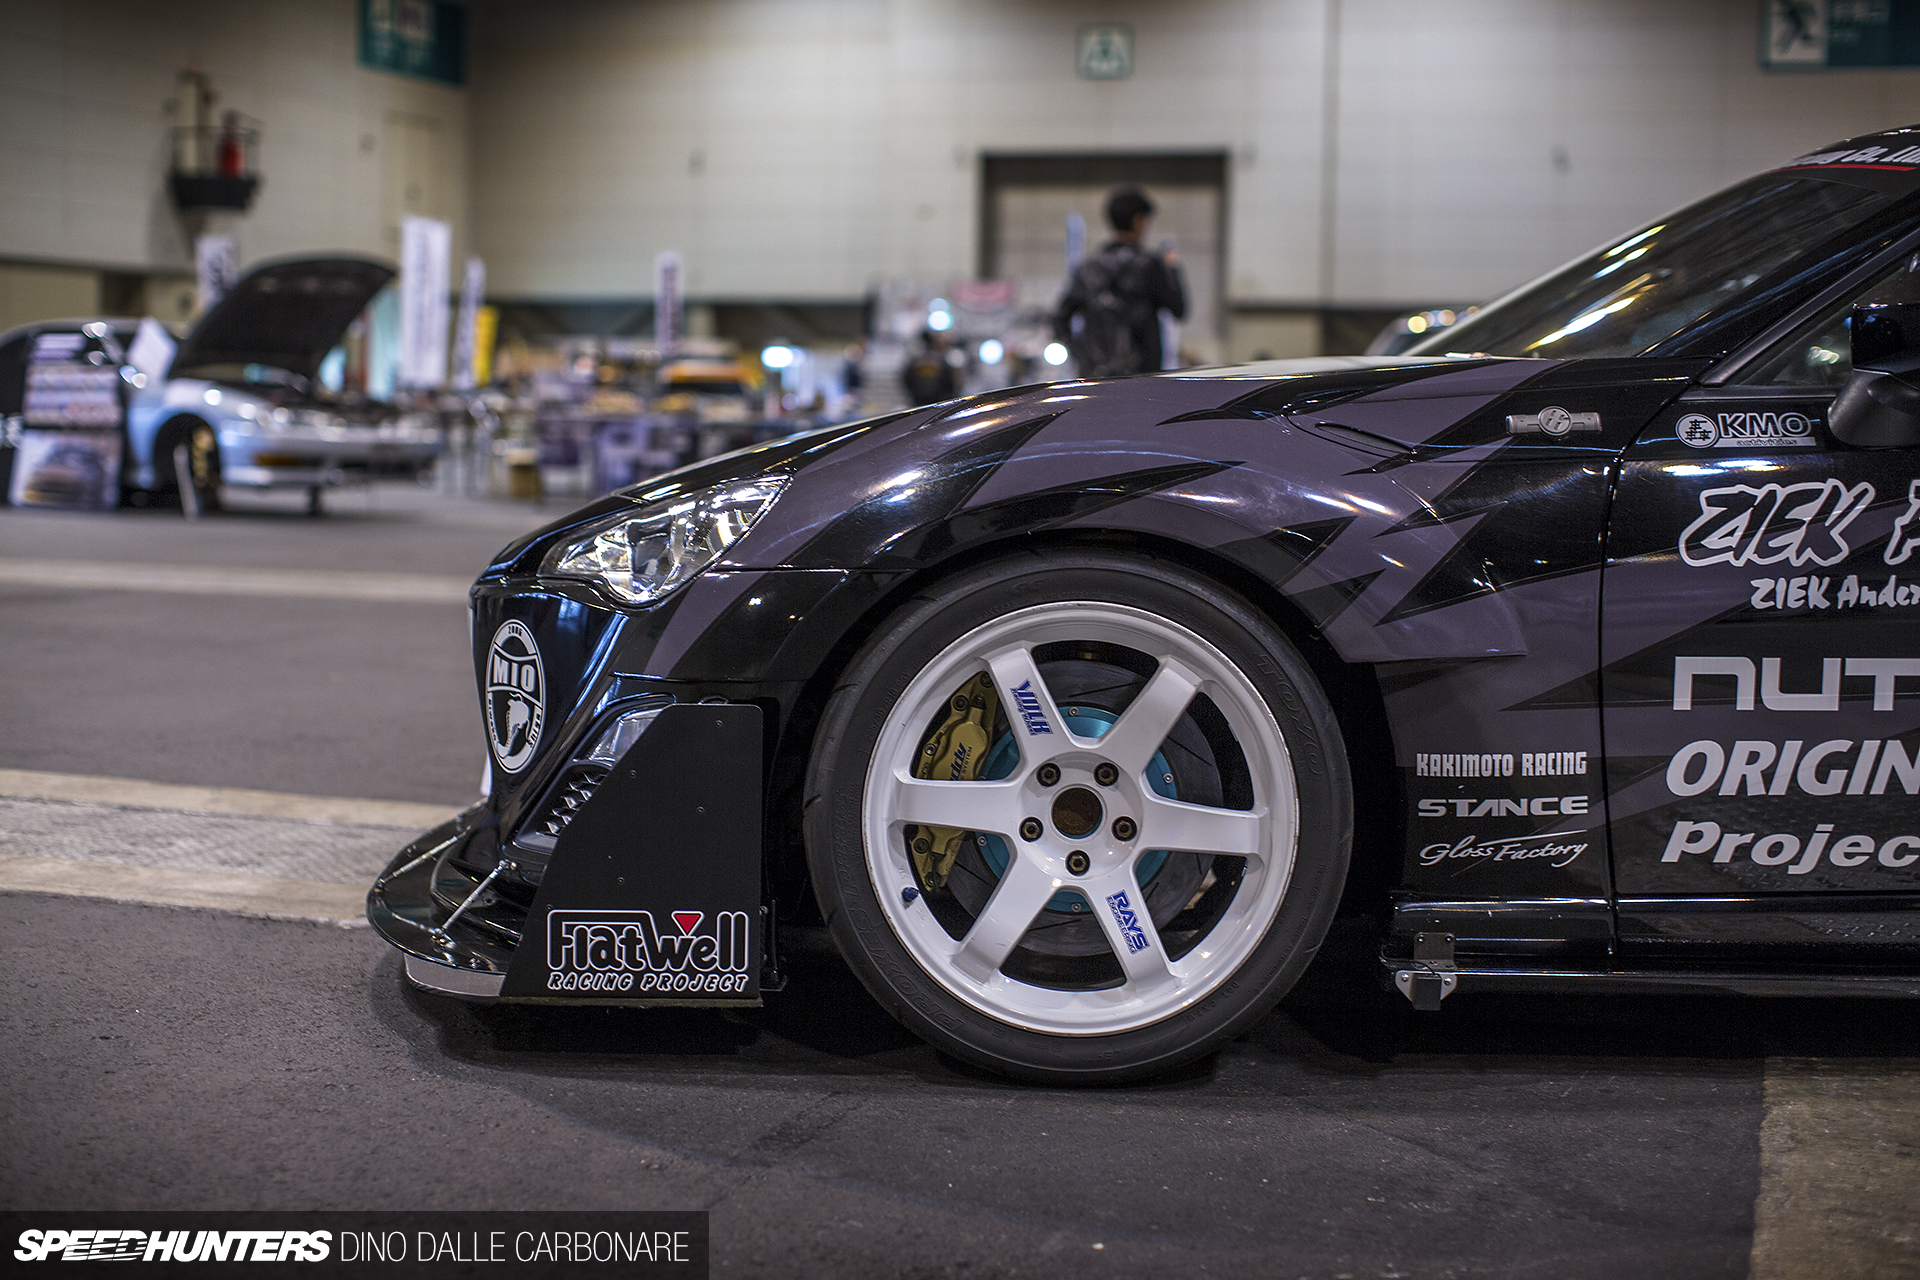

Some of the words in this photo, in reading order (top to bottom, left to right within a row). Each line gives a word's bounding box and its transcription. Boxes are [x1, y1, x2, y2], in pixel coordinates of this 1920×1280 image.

[1717, 412, 1811, 437] KMO
[1679, 478, 1876, 567] ZIEK
[1750, 577, 1831, 609] ZIEK
[493, 653, 536, 692] MIO
[1016, 679, 1052, 734] VOLK
[1416, 753, 1514, 777] KAKIMOTO
[1521, 751, 1588, 776] RACING
[1418, 795, 1589, 817] STANCE
[1419, 835, 1495, 866] Gloss
[1488, 839, 1589, 868] Factory
[1112, 891, 1149, 951] RAYS
[547, 972, 635, 991] RACING
[640, 974, 750, 992] PROJECT
